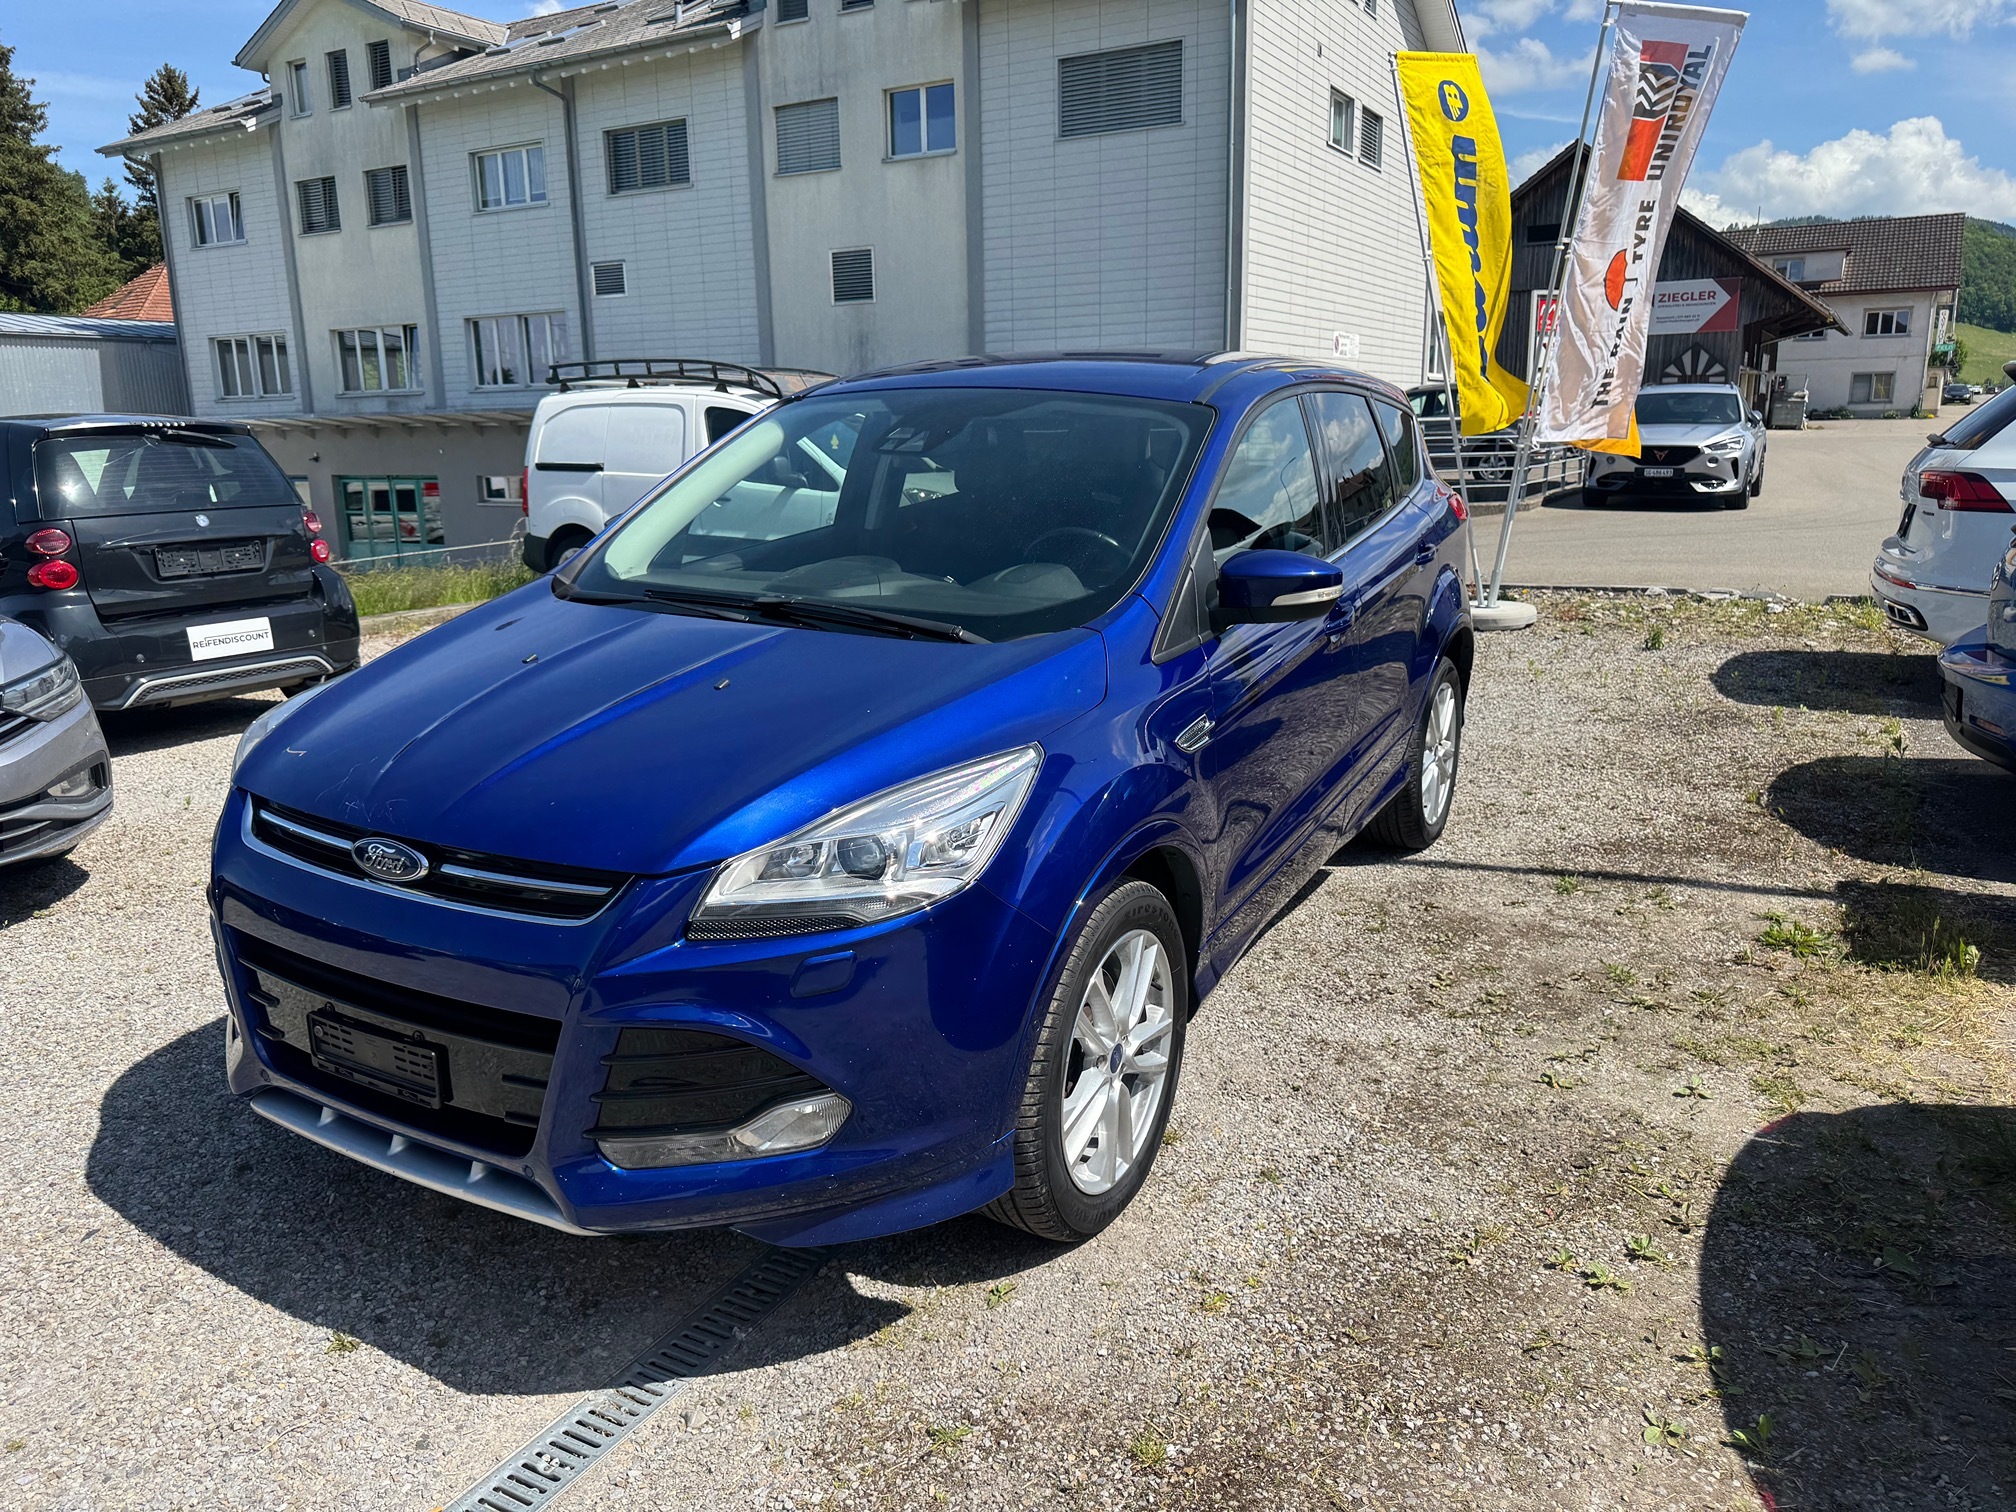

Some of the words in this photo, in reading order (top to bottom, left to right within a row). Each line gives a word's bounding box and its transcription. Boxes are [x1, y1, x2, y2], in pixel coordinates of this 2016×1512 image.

[1647, 45, 1712, 181] UNIROYAL
[1591, 367, 1615, 409] THE
[1610, 297, 1634, 358] RAIN
[1632, 200, 1656, 264] TYRE
[1658, 290, 1717, 303] ZIEGLER
[192, 631, 270, 649] REIFENDISCOUNT
[363, 843, 412, 874] Ford
[1123, 903, 1179, 940] Firestone
